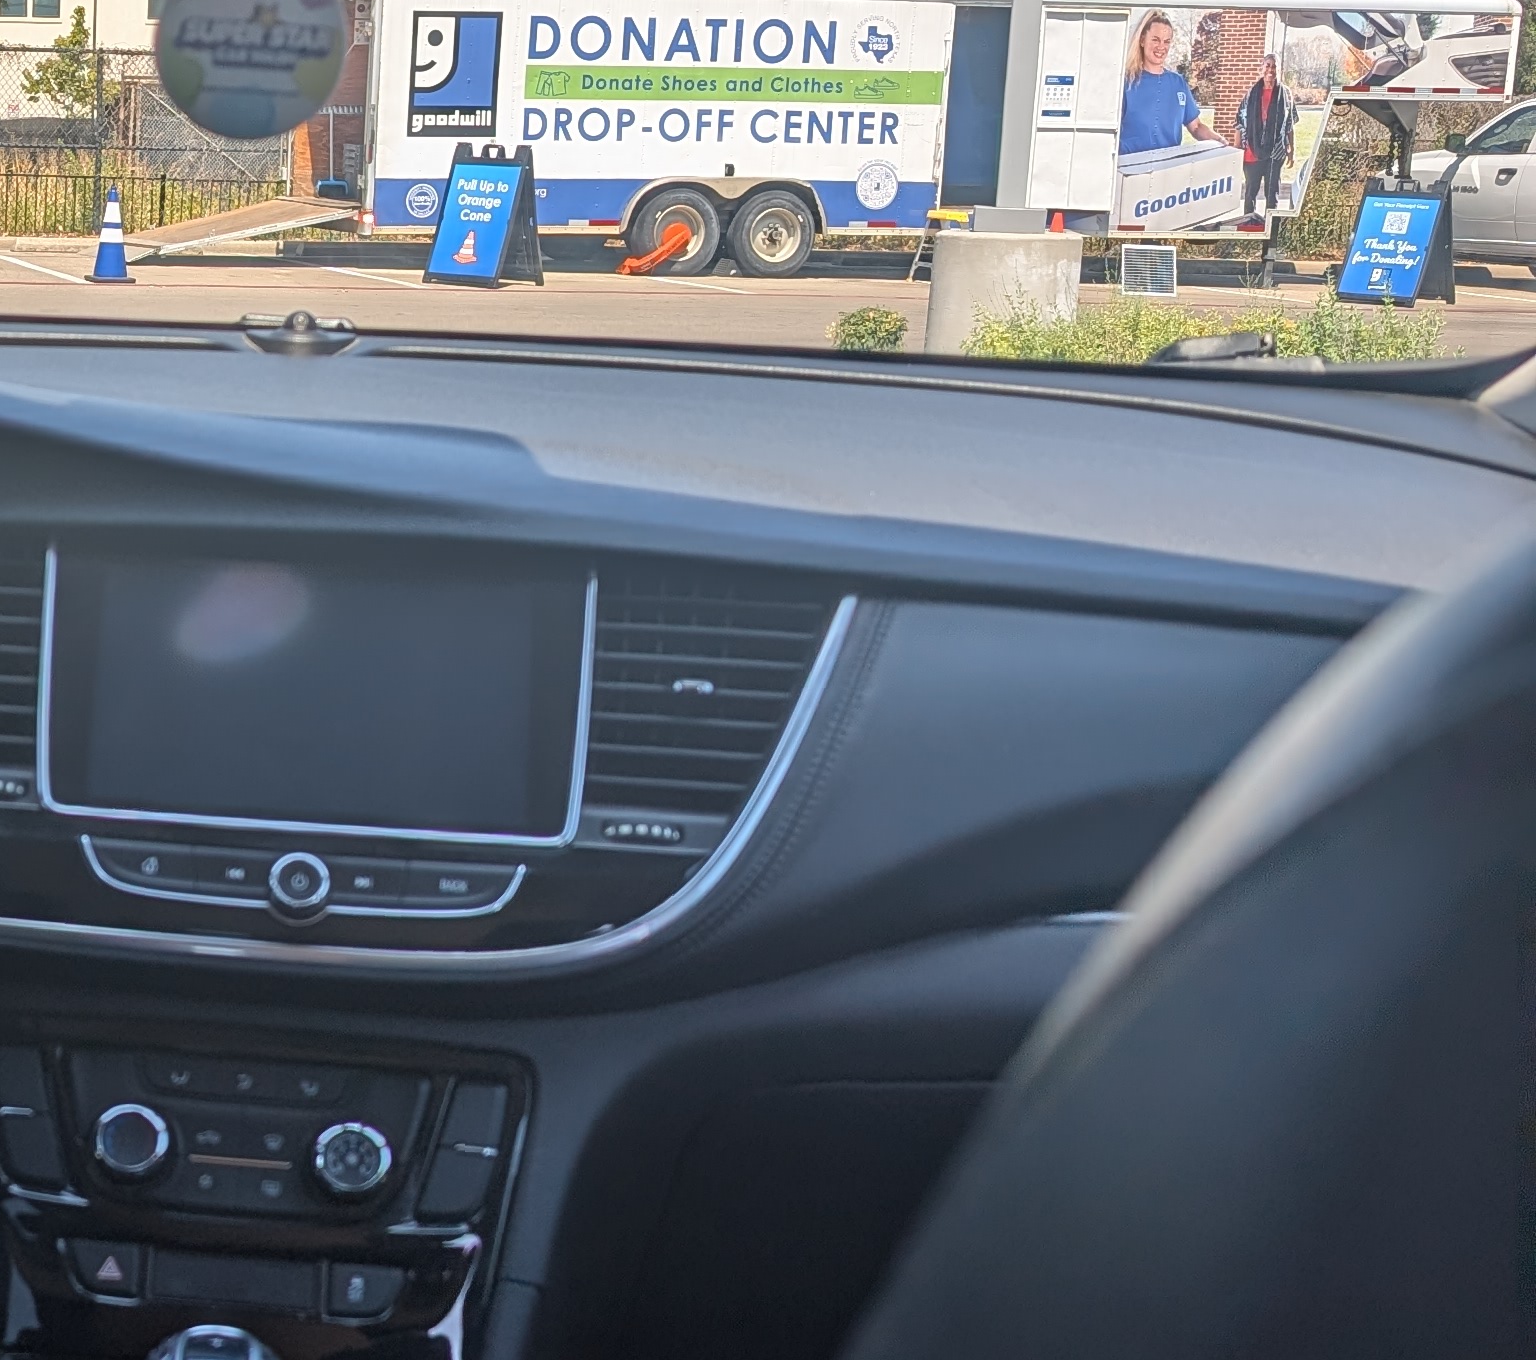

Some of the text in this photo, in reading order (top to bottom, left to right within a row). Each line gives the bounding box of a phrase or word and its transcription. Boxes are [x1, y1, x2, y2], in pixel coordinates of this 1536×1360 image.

[528, 15, 837, 65] DONATION
[582, 74, 843, 94] Donate Shoes and Clothes
[411, 109, 492, 133] goodwill
[522, 107, 900, 145] DROP-OFF CENTER
[457, 178, 509, 195] Pull Up to
[1134, 175, 1233, 218] Goodwill
[457, 193, 502, 210] Orange
[460, 209, 492, 222] Cone
[1364, 237, 1418, 254] Thank You
[1351, 250, 1421, 270] for Donating!
